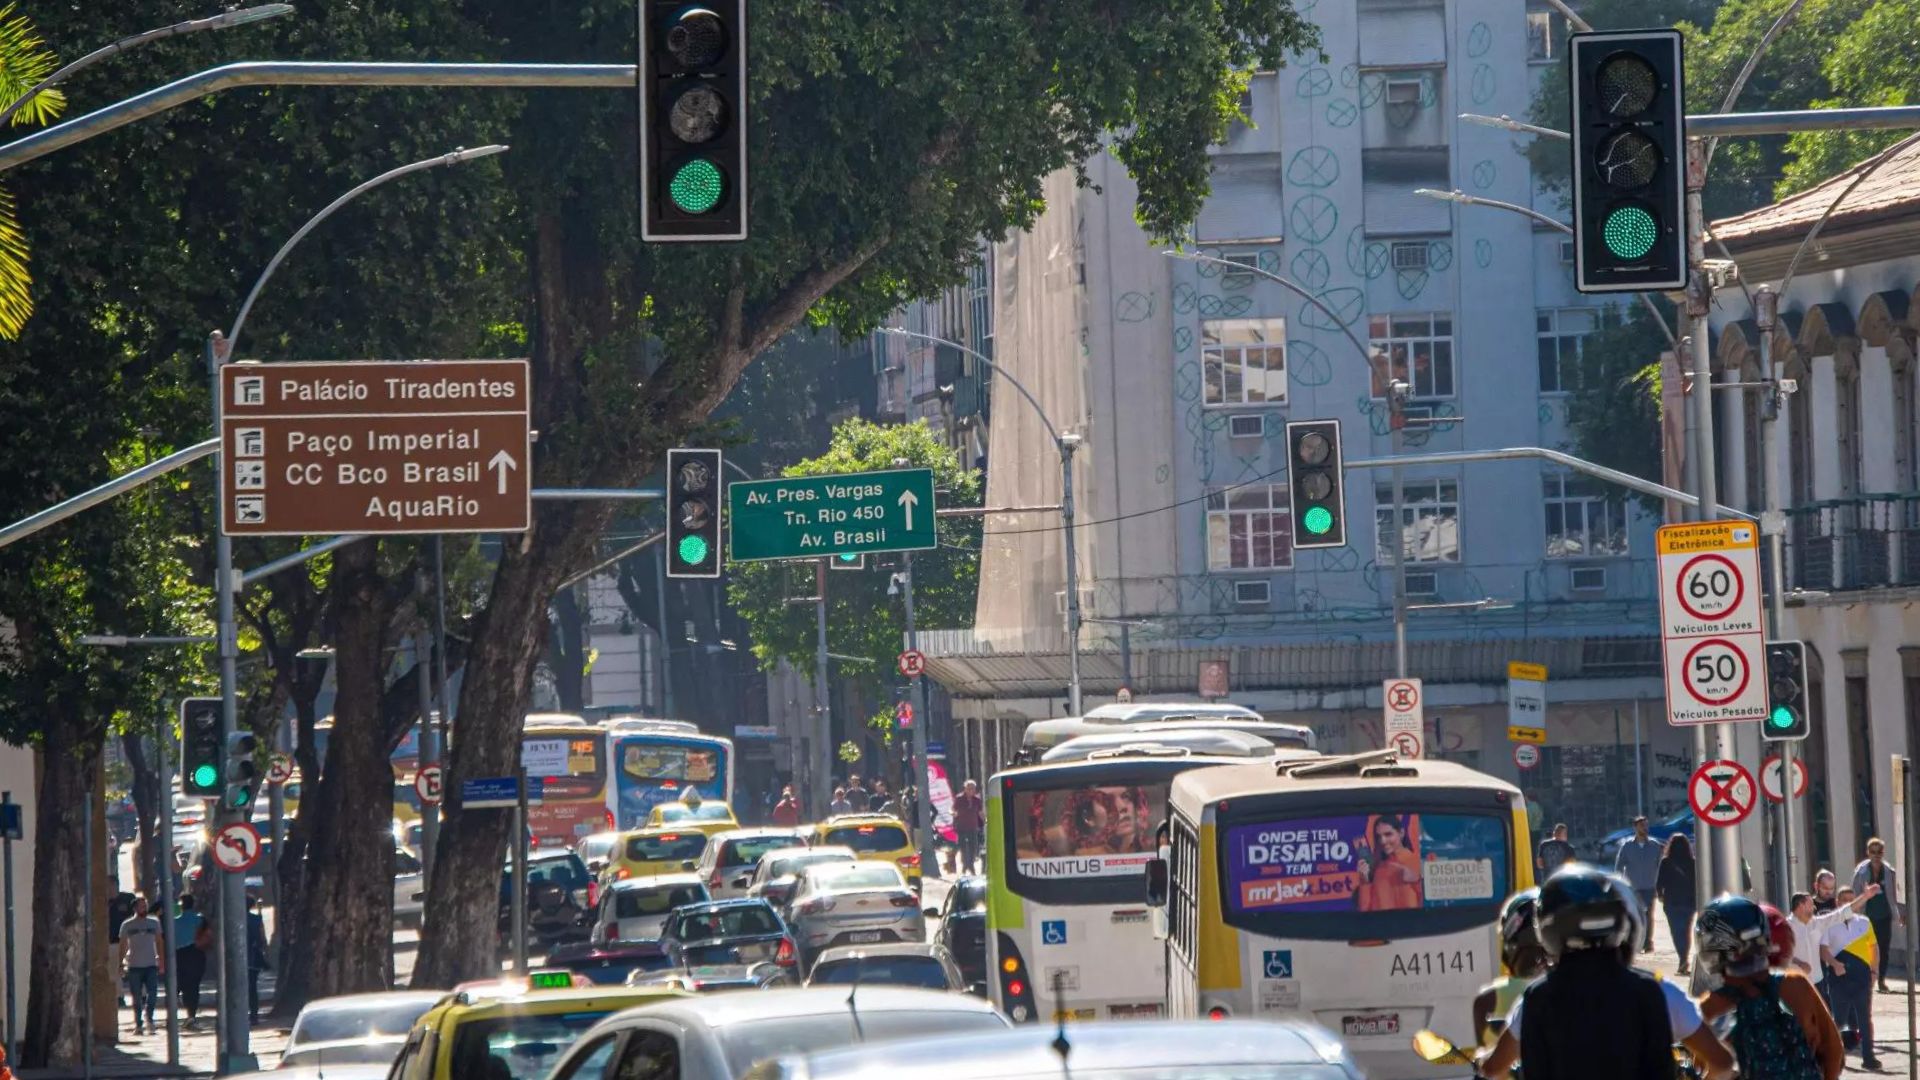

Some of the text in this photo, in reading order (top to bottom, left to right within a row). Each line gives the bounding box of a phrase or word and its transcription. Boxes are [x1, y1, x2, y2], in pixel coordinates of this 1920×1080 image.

[280, 377, 515, 401] Palácio Tiradentes
[287, 428, 480, 456] Paço Imperial
[285, 461, 480, 486] CC Bco Brasil
[746, 484, 883, 505] Av. Pres. Vargas
[365, 495, 480, 522] AquaRio
[784, 506, 884, 526] Tn. Rio 450
[800, 528, 886, 548] Av. Brasil
[1663, 526, 1730, 539] Fiscalização
[1669, 539, 1725, 550] Eletrônica
[1689, 569, 1730, 598] 60
[1700, 601, 1722, 610] km/h
[1723, 621, 1753, 631] Leves
[1695, 654, 1736, 683] 50
[1706, 686, 1728, 695] km/h
[1722, 706, 1765, 717] Pesados
[1258, 829, 1338, 844] ONDE TEM
[1248, 841, 1352, 864] DESAFIO,
[1020, 859, 1101, 877] TINNITUS
[1286, 863, 1312, 875] TEM
[1429, 862, 1485, 876] DISQUE
[1390, 950, 1474, 976] A41141
[533, 974, 569, 989] TAXI
